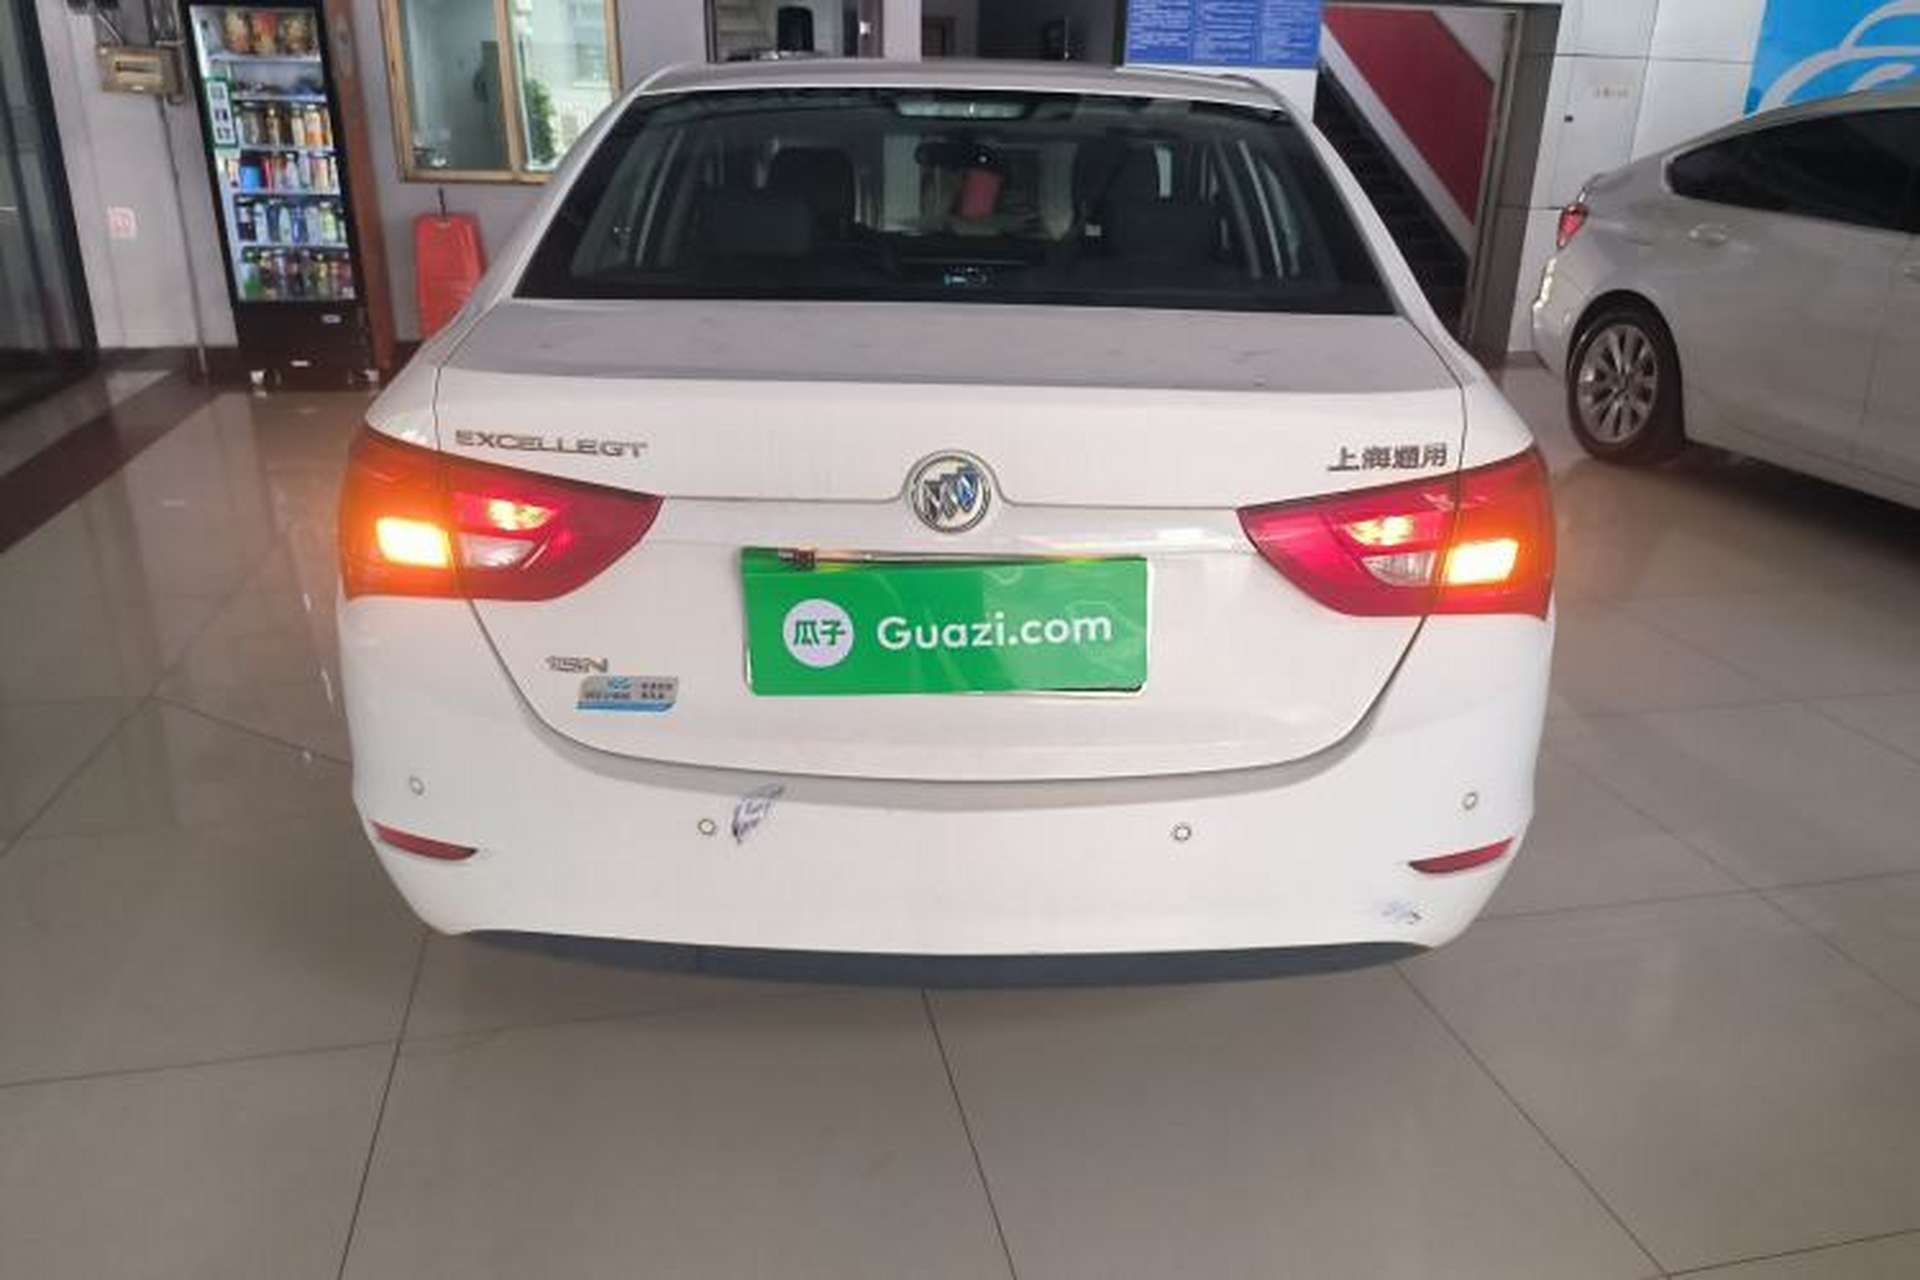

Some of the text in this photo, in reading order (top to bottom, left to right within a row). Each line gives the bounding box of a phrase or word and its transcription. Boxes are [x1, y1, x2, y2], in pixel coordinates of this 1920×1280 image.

[1327, 442, 1448, 471] 上海通用
[792, 619, 847, 648] 瓜子
[876, 610, 1113, 651] Guazi.com
